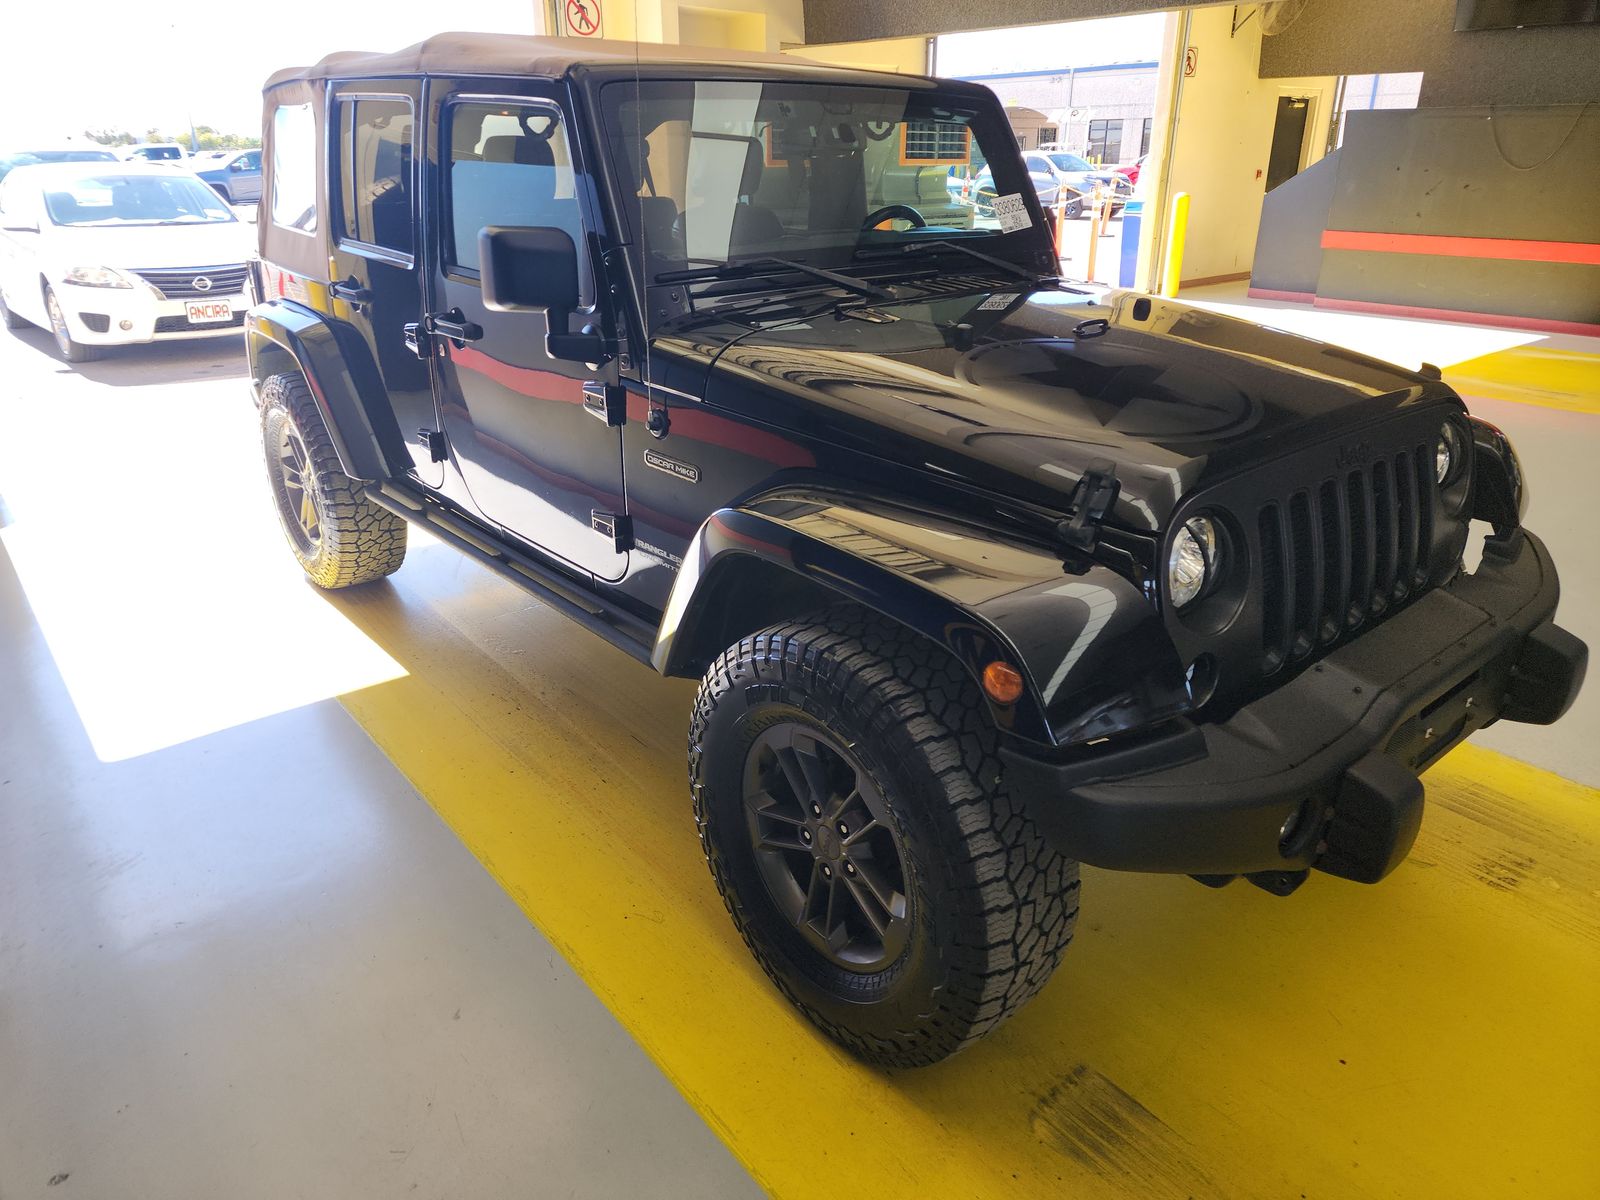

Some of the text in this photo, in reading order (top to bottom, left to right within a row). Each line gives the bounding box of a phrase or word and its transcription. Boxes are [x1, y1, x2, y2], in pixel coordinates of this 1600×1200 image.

[190, 304, 230, 320] ANCIRA
[647, 455, 695, 478] OSCAR MIKE
